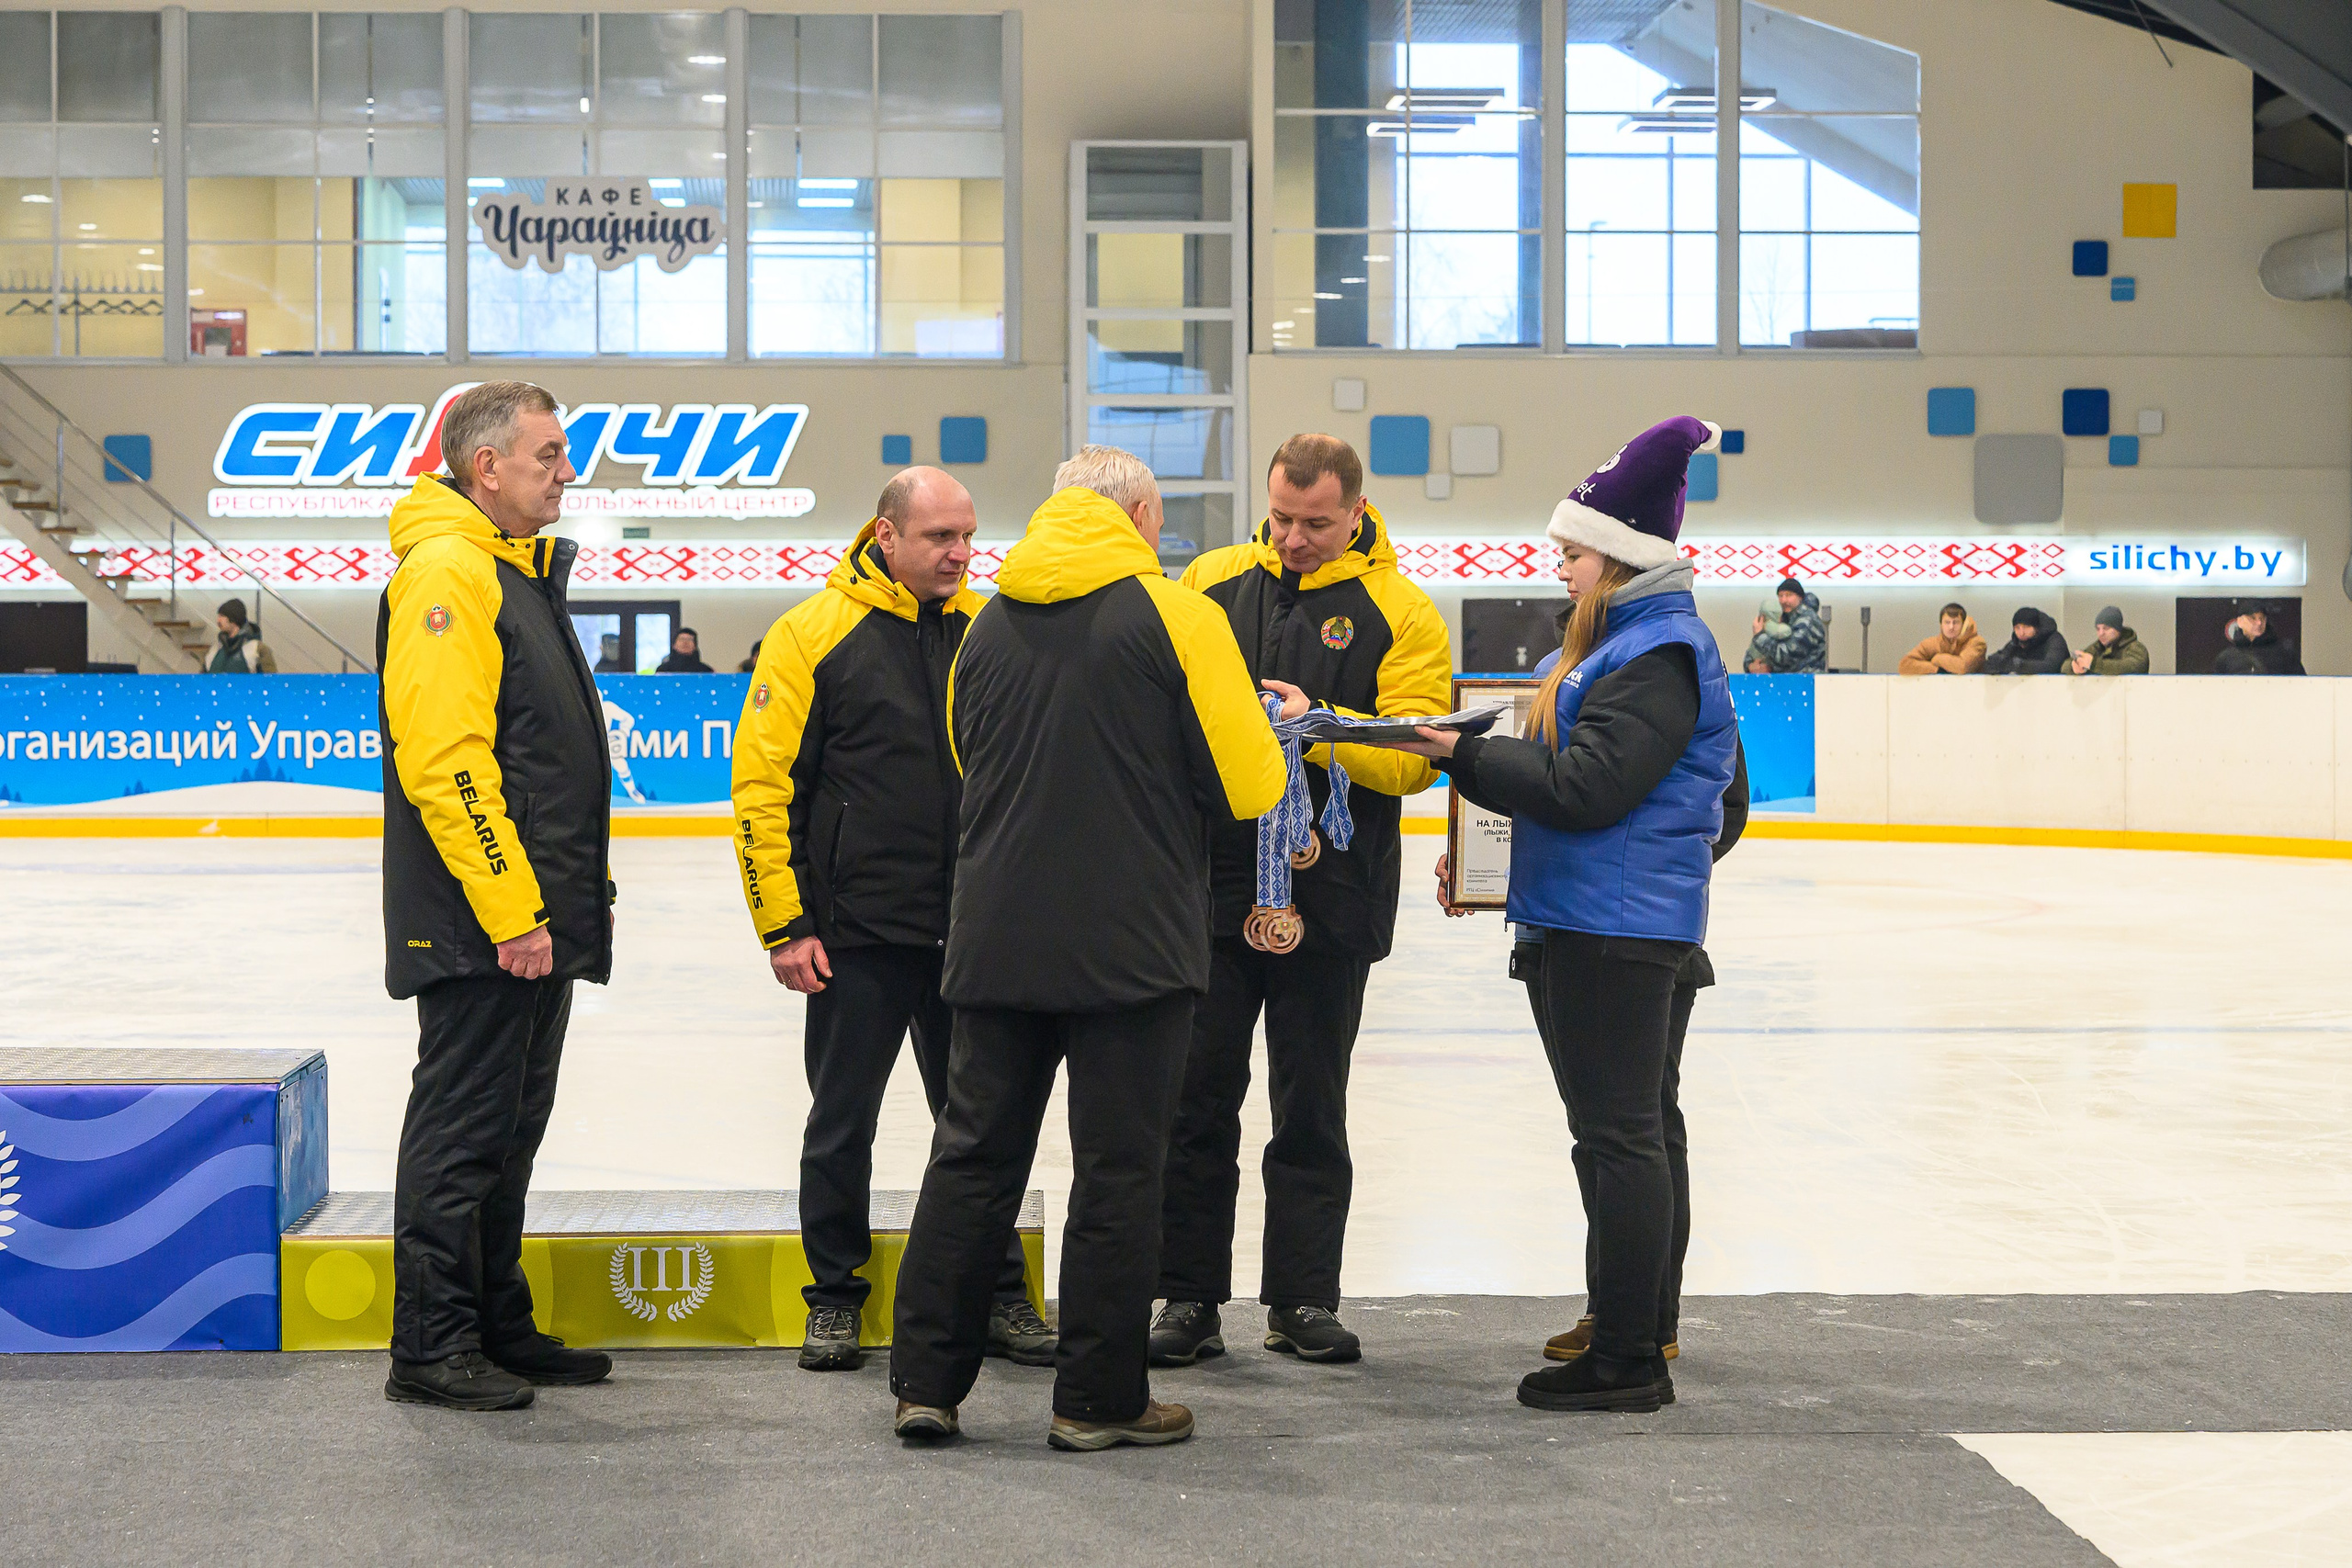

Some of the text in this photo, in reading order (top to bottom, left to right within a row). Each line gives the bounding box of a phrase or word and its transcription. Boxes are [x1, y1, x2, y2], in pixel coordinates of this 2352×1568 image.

[556, 187, 642, 205] КАФЕ
[483, 204, 715, 264] Чараўніца
[215, 492, 808, 512] РЕСПУБЛИКА ОЛЫЖНЫЙ ЦЕНТР
[2089, 545, 2283, 577] silichy.by
[0, 720, 237, 767] ганизаций
[248, 720, 383, 769] Управ
[453, 769, 509, 876] BELARUS
[1476, 819, 1490, 828] НА
[741, 818, 764, 910] BELARUS
[407, 940, 433, 948] ORAZ
[627, 1247, 696, 1292] III
